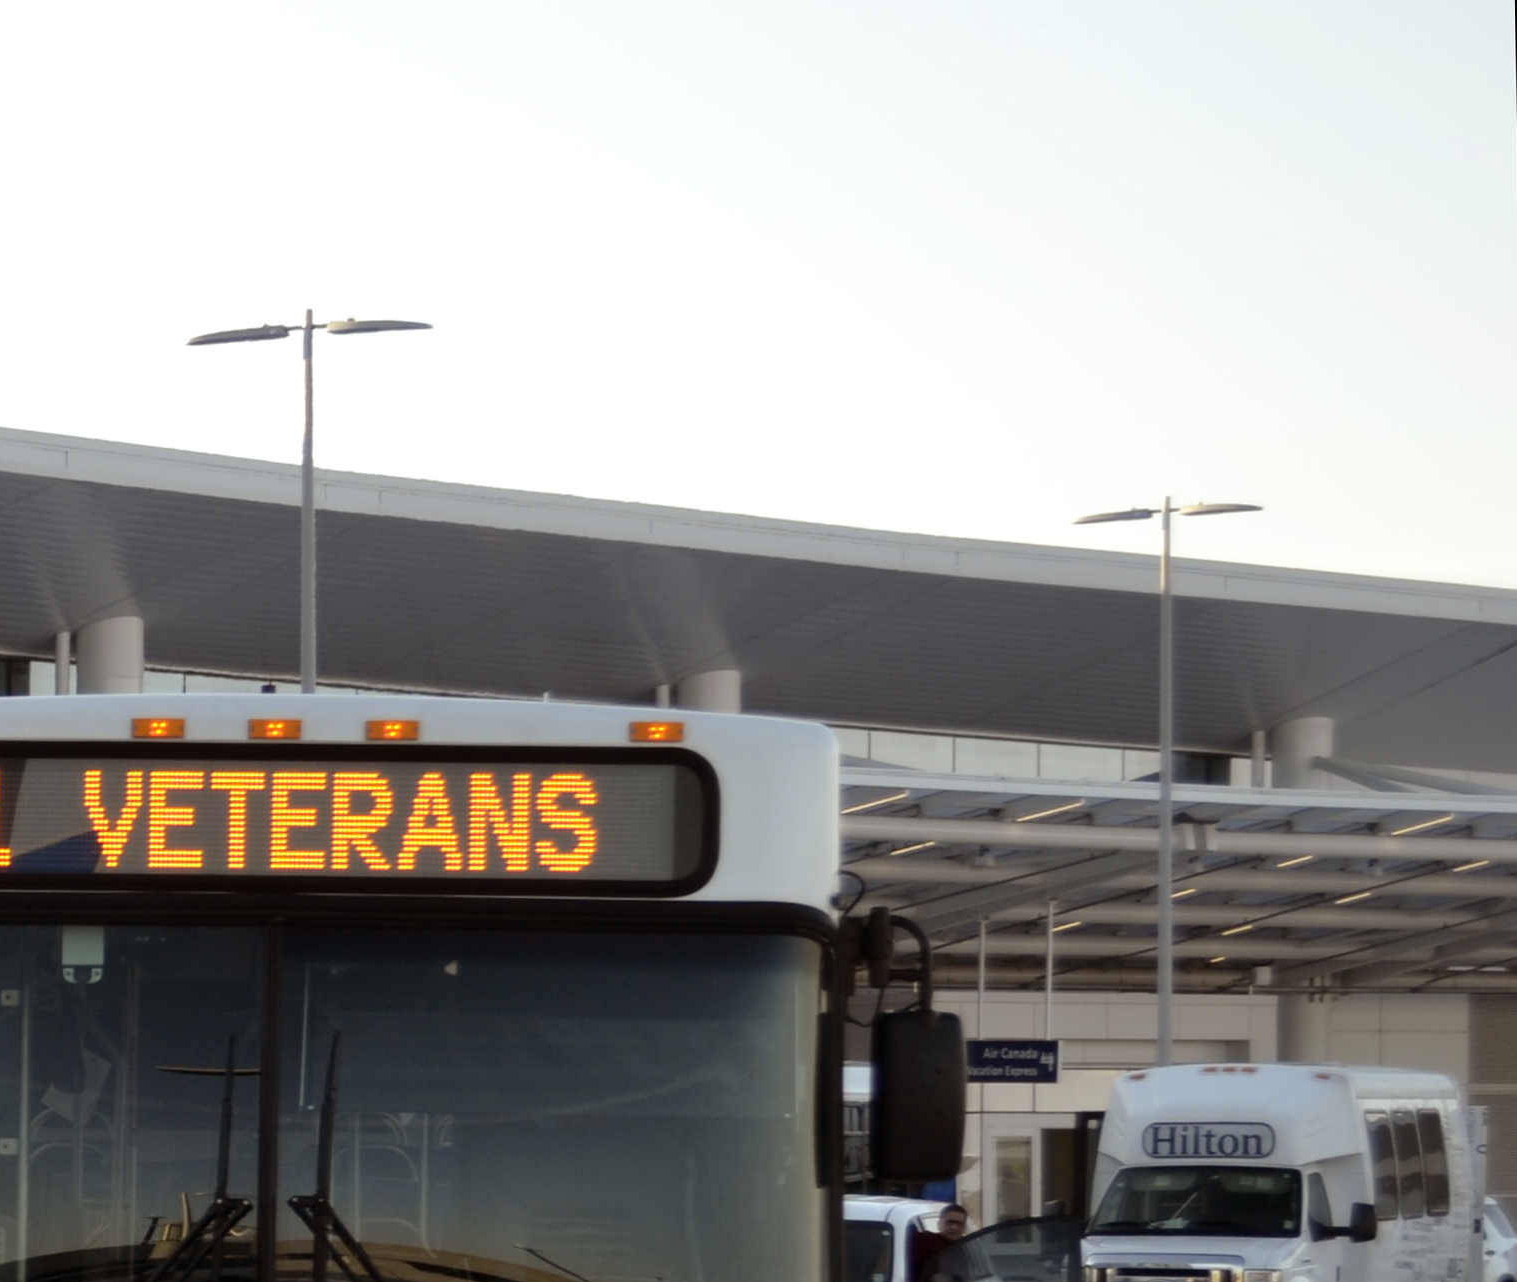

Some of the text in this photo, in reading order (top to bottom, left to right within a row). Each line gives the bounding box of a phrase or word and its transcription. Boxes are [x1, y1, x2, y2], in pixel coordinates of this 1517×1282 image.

[83, 770, 599, 873] VETERANS
[983, 1047, 1039, 1059] Air Canada
[1005, 1065, 1038, 1078] Express
[1150, 1126, 1264, 1157] Hilton
